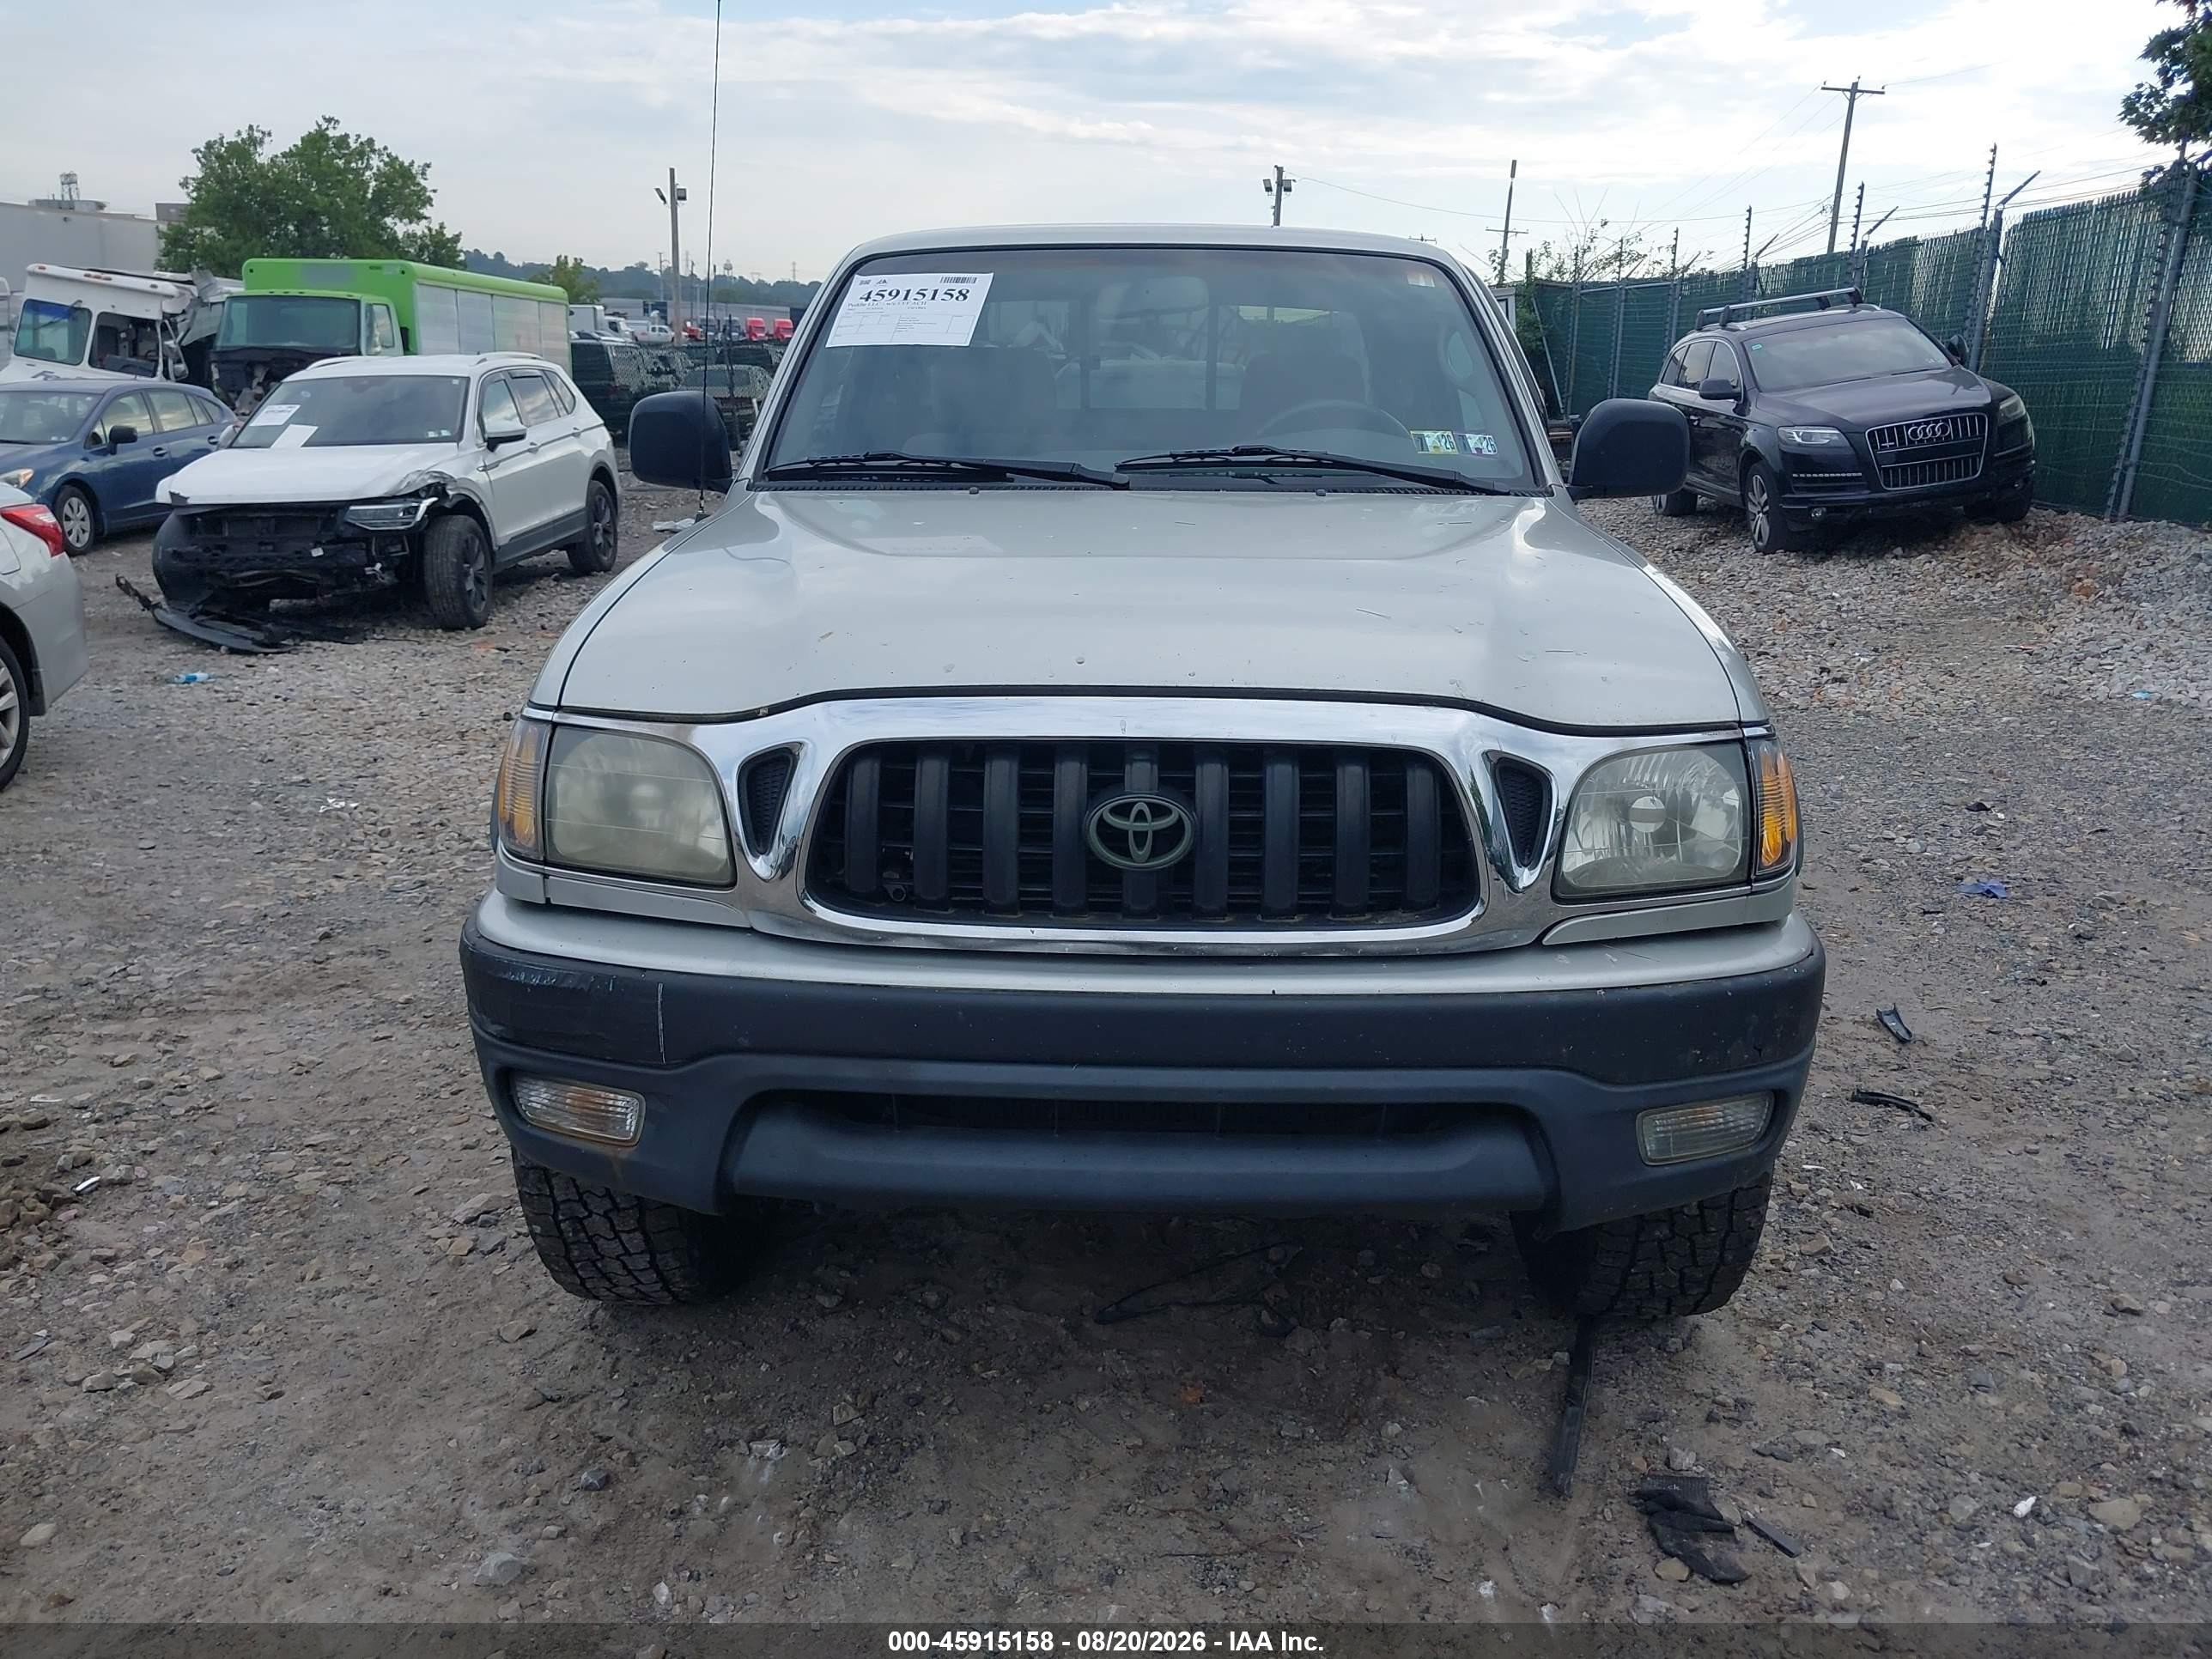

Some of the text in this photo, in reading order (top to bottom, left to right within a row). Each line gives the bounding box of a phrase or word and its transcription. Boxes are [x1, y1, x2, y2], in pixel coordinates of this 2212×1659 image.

[860, 288, 970, 302] 45915158
[1442, 434, 1455, 450] 26
[1483, 436, 1497, 453] 26
